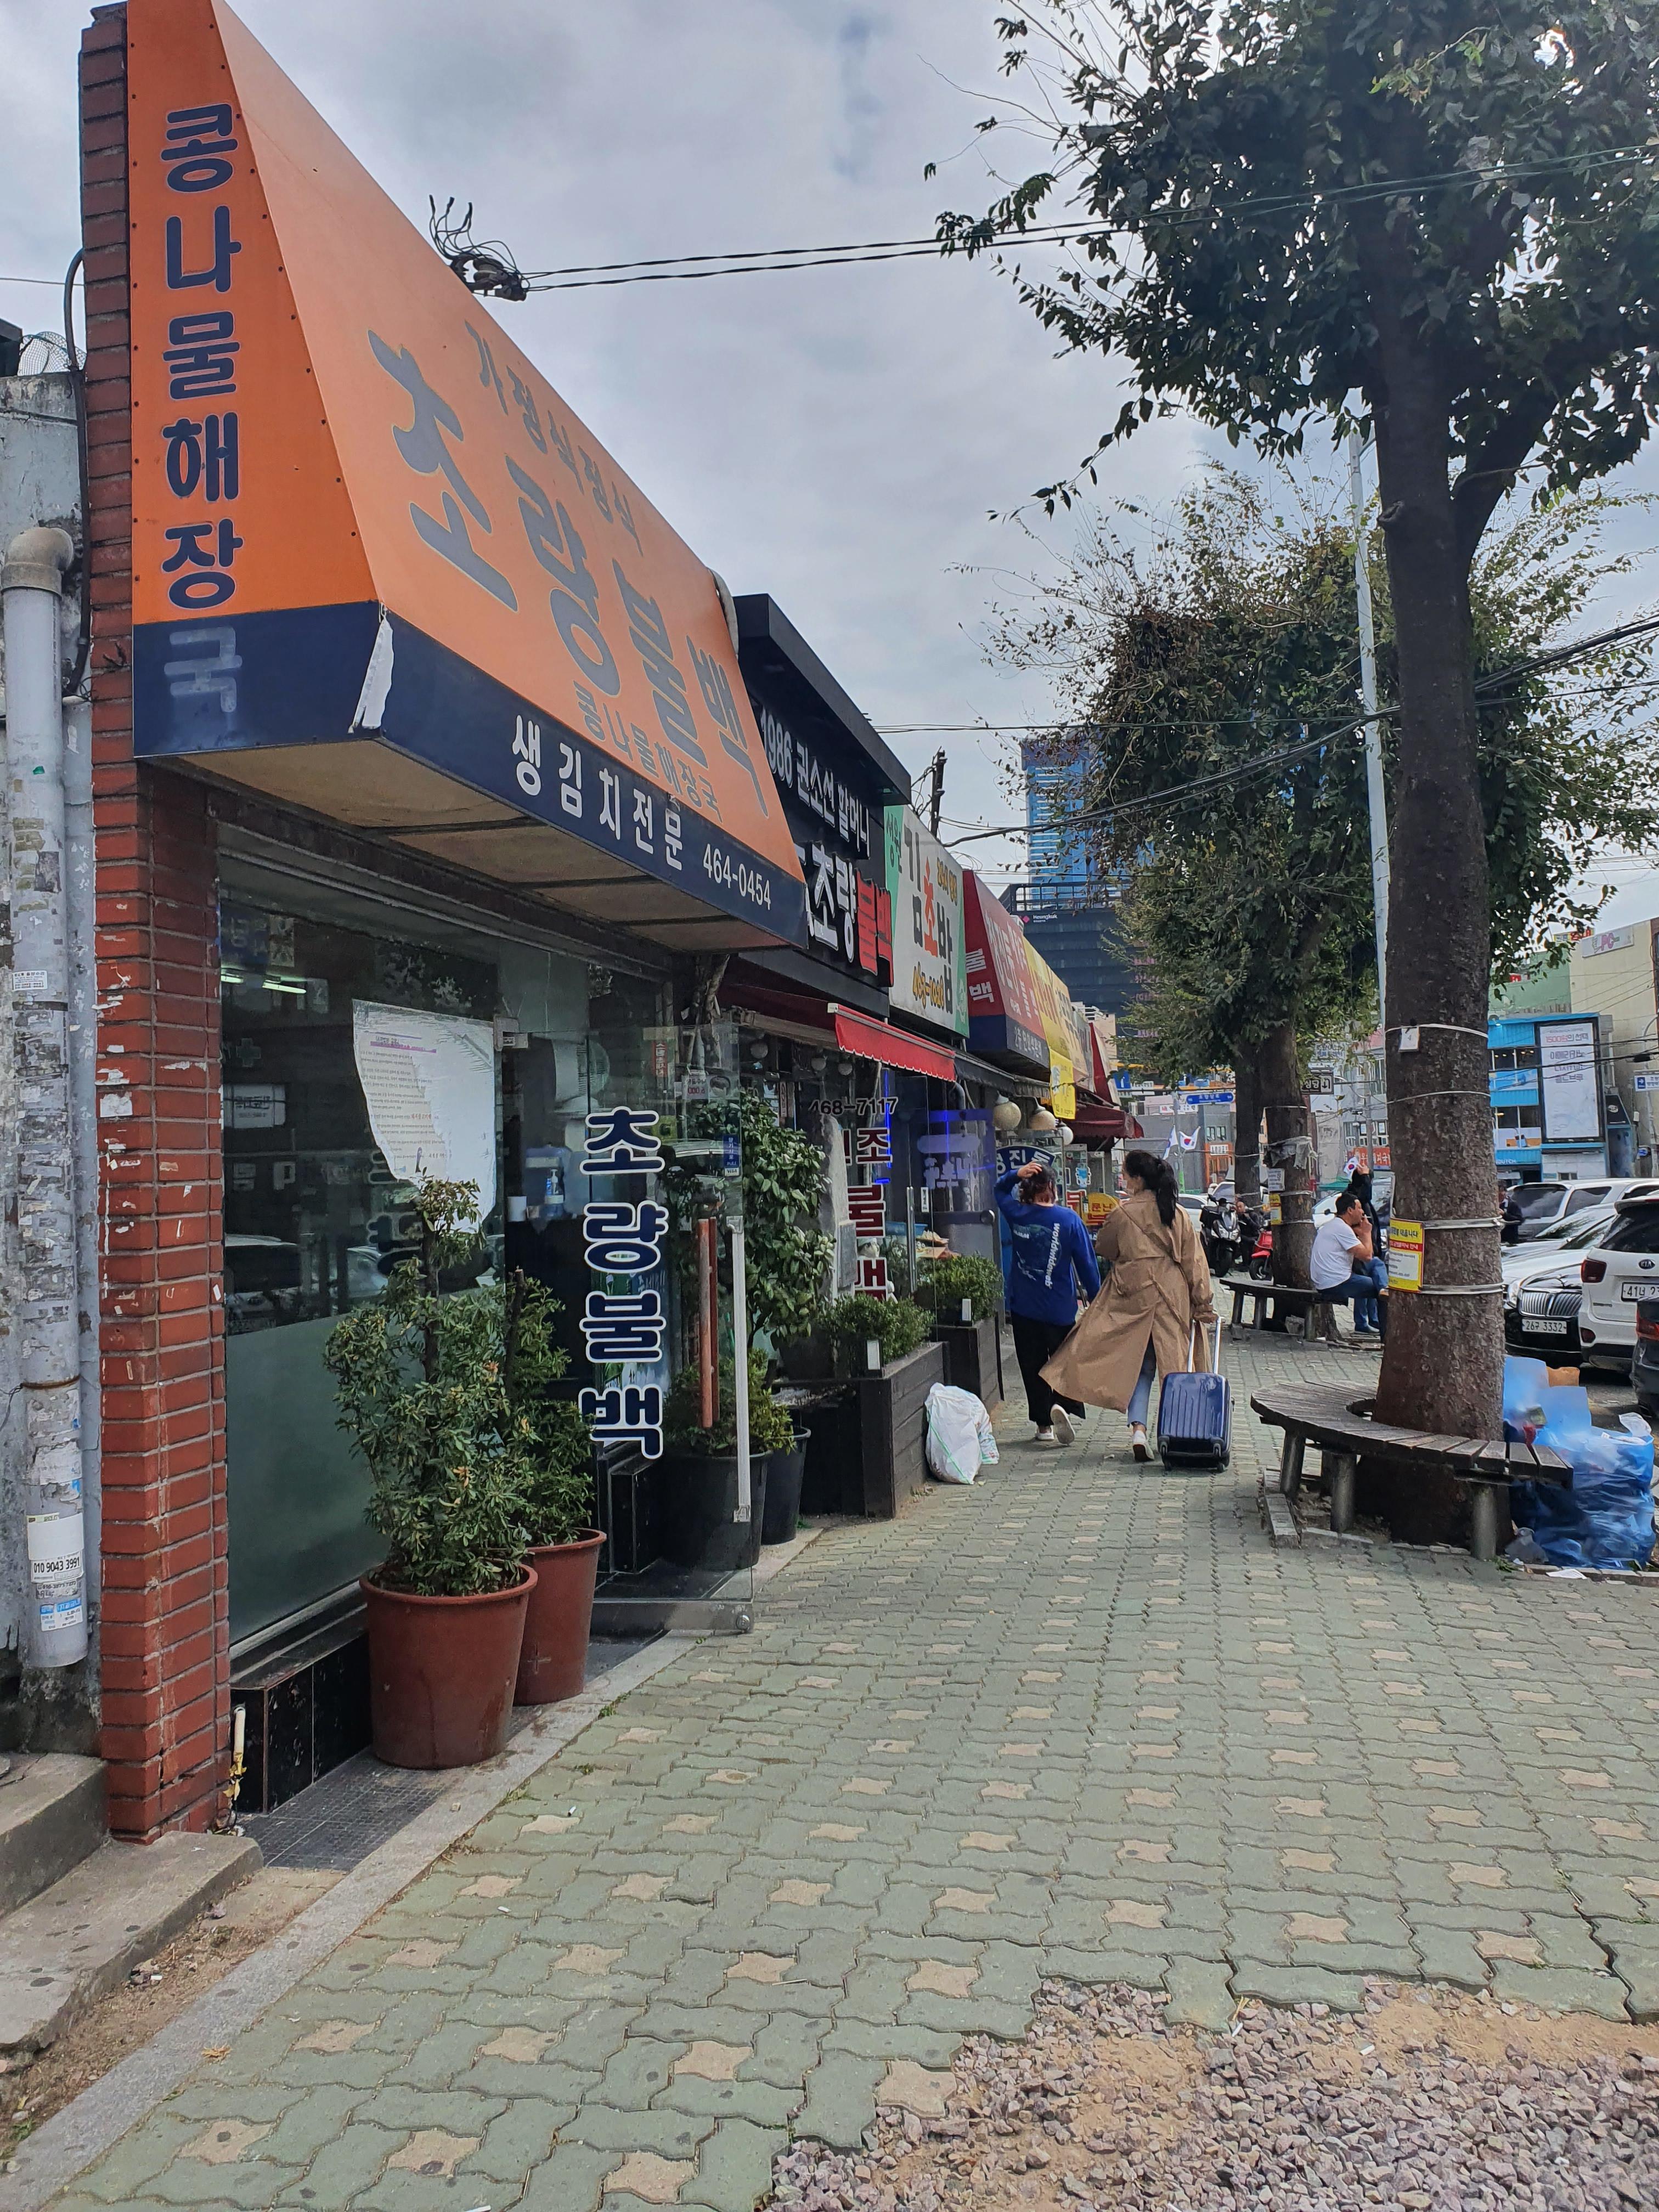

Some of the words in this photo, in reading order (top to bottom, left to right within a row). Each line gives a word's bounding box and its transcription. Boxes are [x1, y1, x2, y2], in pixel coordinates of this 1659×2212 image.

[367, 329, 769, 819] 초량불백
[573, 679, 724, 823] 콩나물해장국
[761, 709, 793, 788] 1986
[797, 741, 836, 828] 권소선
[838, 784, 871, 860] 할머니
[703, 843, 771, 910] 464-0454
[578, 1105, 669, 1460] 초량불백
[1543, 1322, 1562, 1332] 3332
[33, 1563, 44, 1573] 010
[46, 1560, 64, 1573] 9043
[65, 1557, 80, 1569] 3991
